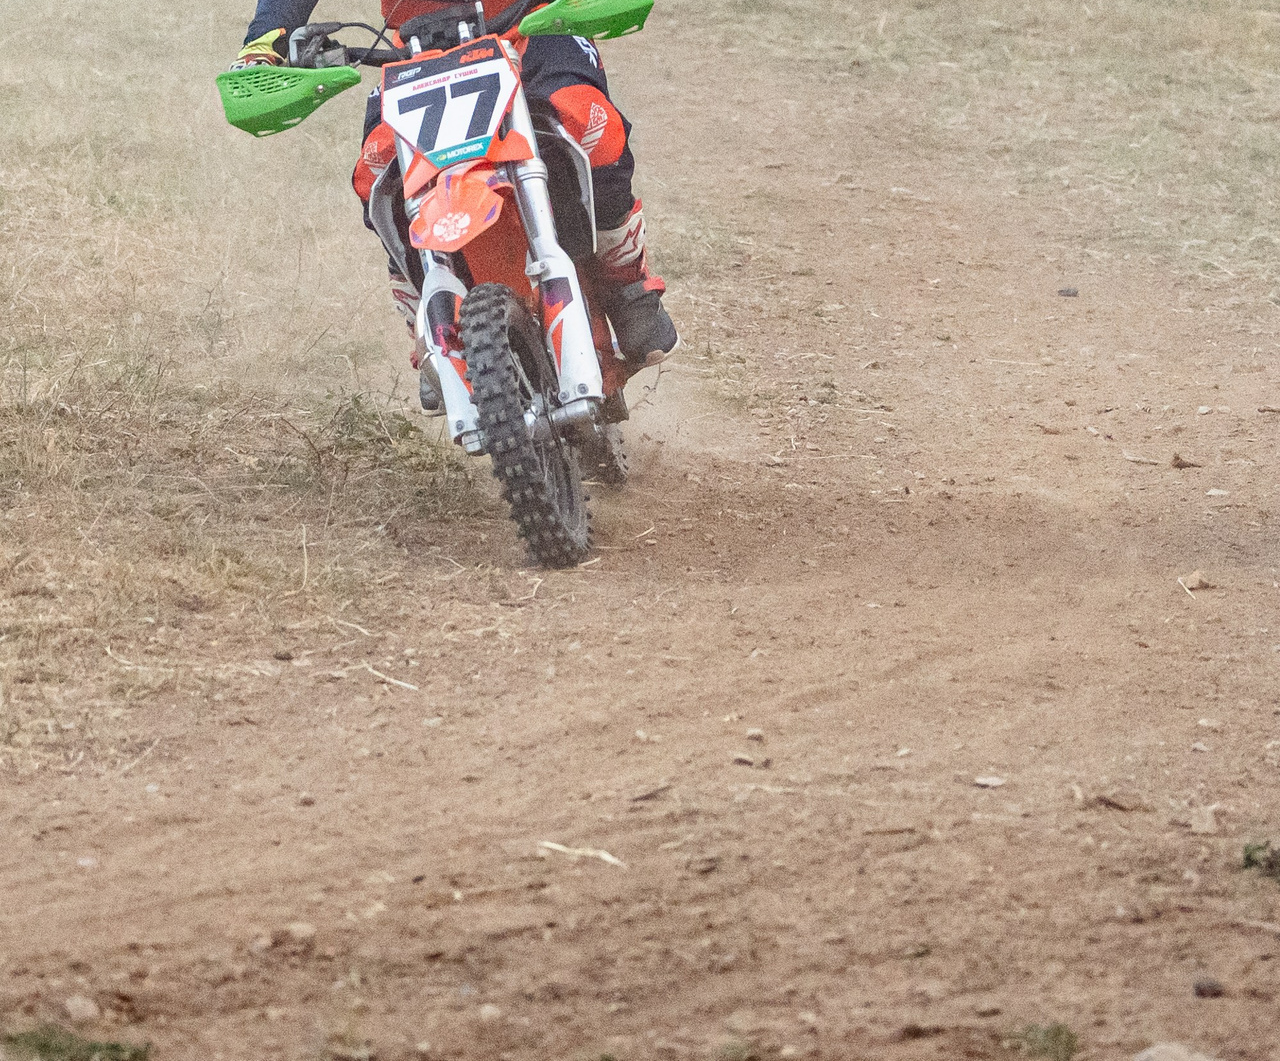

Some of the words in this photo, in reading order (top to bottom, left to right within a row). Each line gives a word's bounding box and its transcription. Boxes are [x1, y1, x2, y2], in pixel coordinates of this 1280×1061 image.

[460, 48, 494, 64] KTM
[397, 72, 501, 153] 77
[446, 142, 484, 159] MOTOREX
